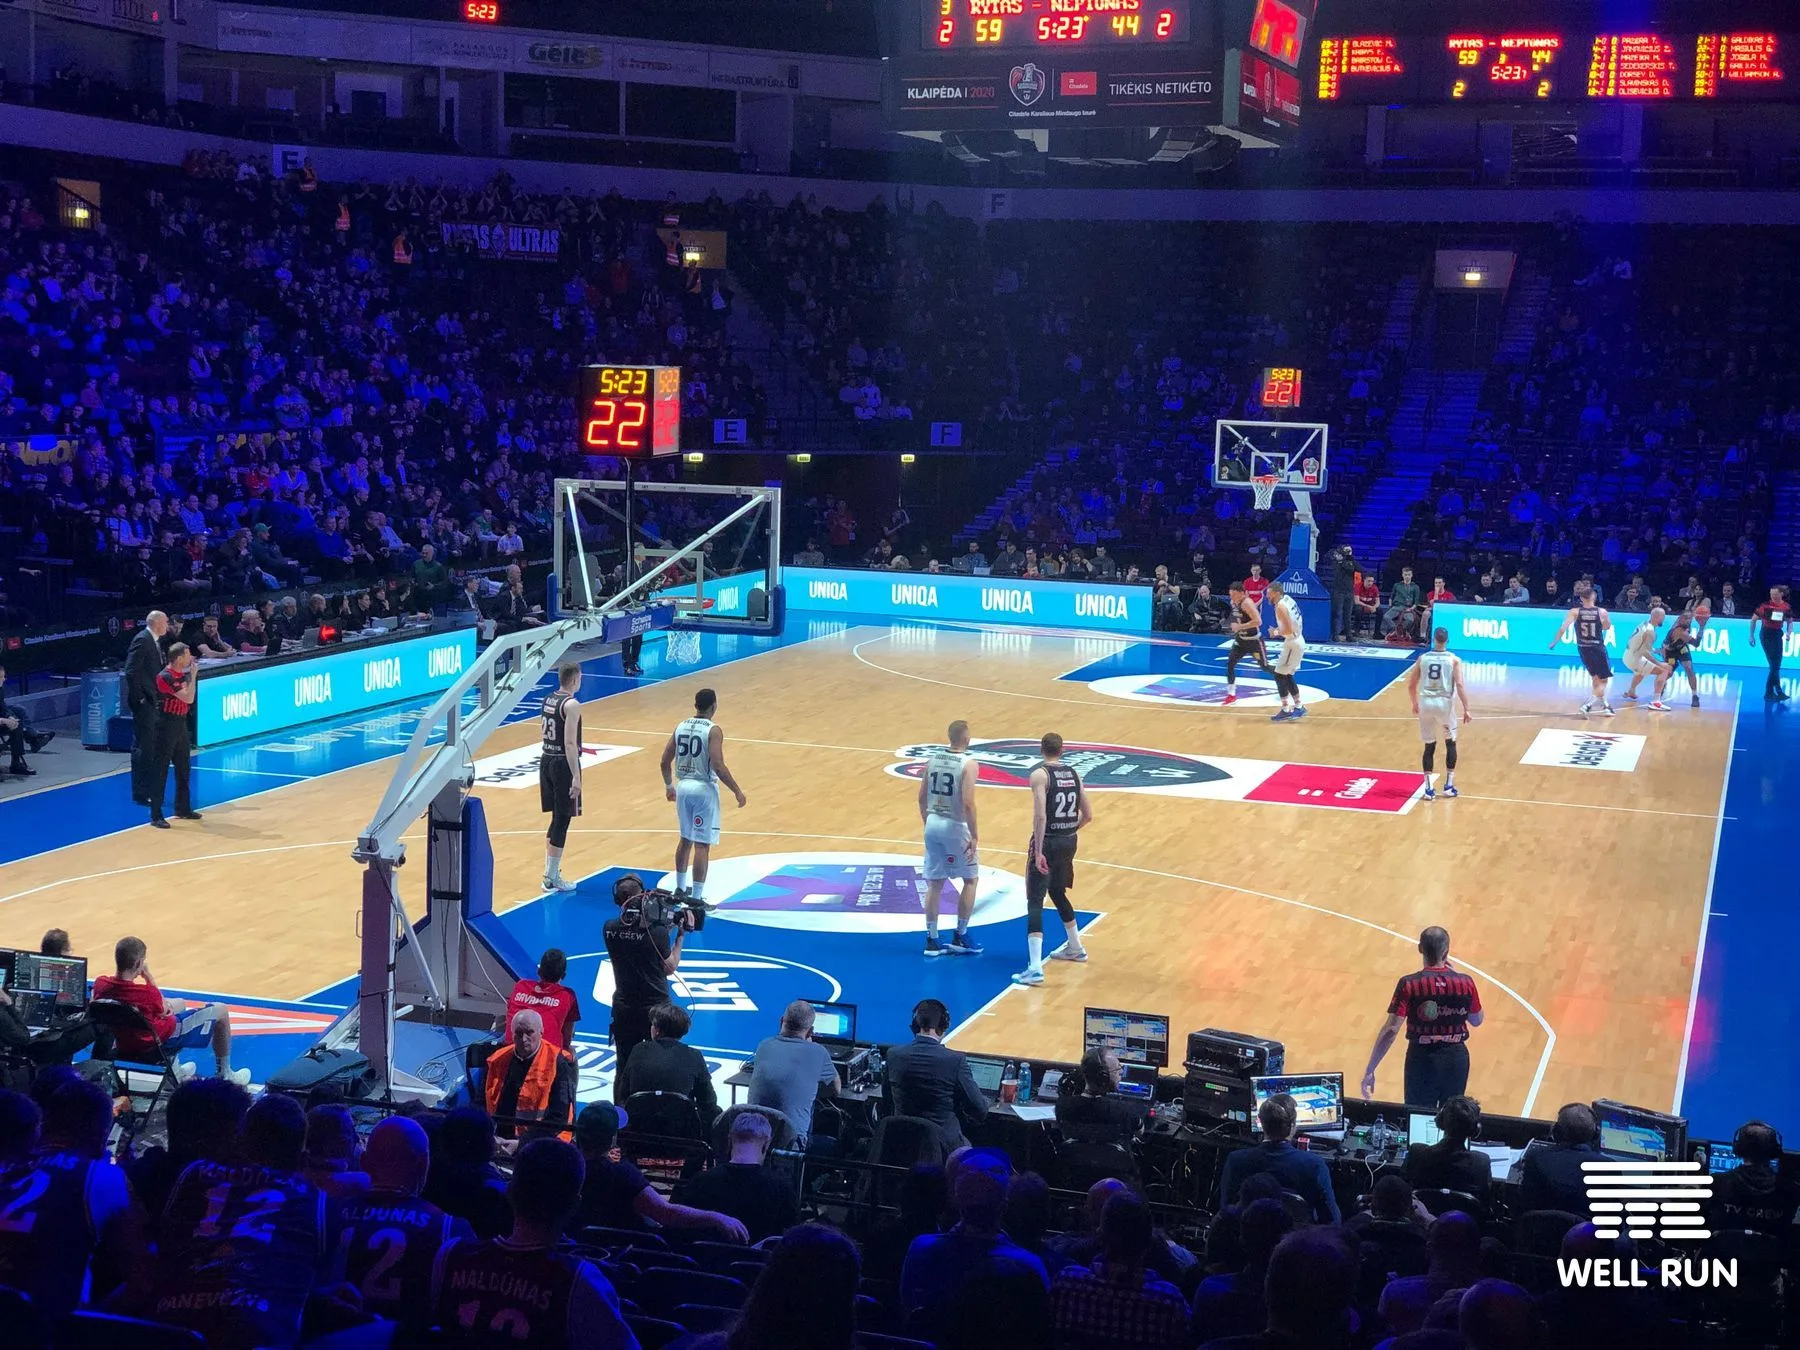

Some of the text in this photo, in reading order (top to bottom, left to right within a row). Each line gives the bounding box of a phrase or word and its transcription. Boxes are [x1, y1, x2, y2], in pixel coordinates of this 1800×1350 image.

[467, 3, 497, 20] 5:23
[939, 13, 1171, 42] 2 59 5:23 44 2
[1458, 50, 1478, 65] 59
[1531, 50, 1551, 63] 44
[906, 85, 996, 99] KLAIPĖDA 2020
[1109, 80, 1213, 95] TIKĖKIS NETIKĖTO
[1452, 81, 1549, 97] 2 2
[509, 226, 560, 253] ULTRAS
[600, 368, 648, 394] 5:23
[1263, 381, 1294, 403] 22
[587, 400, 646, 446] 22
[809, 580, 1129, 620] UNIQA UNIQA UNIQA UNIQA
[1283, 581, 1309, 595] UNIQA
[1463, 617, 1509, 640] UNIQA
[428, 644, 461, 678] UNIQA
[1428, 663, 1442, 680] 8
[363, 656, 401, 692] UNIQA
[294, 672, 332, 707] UNIQA
[222, 690, 258, 721] UNIQA
[677, 734, 703, 758] 50
[930, 771, 955, 797] 13
[1054, 791, 1078, 818] 22
[605, 930, 617, 940] TV
